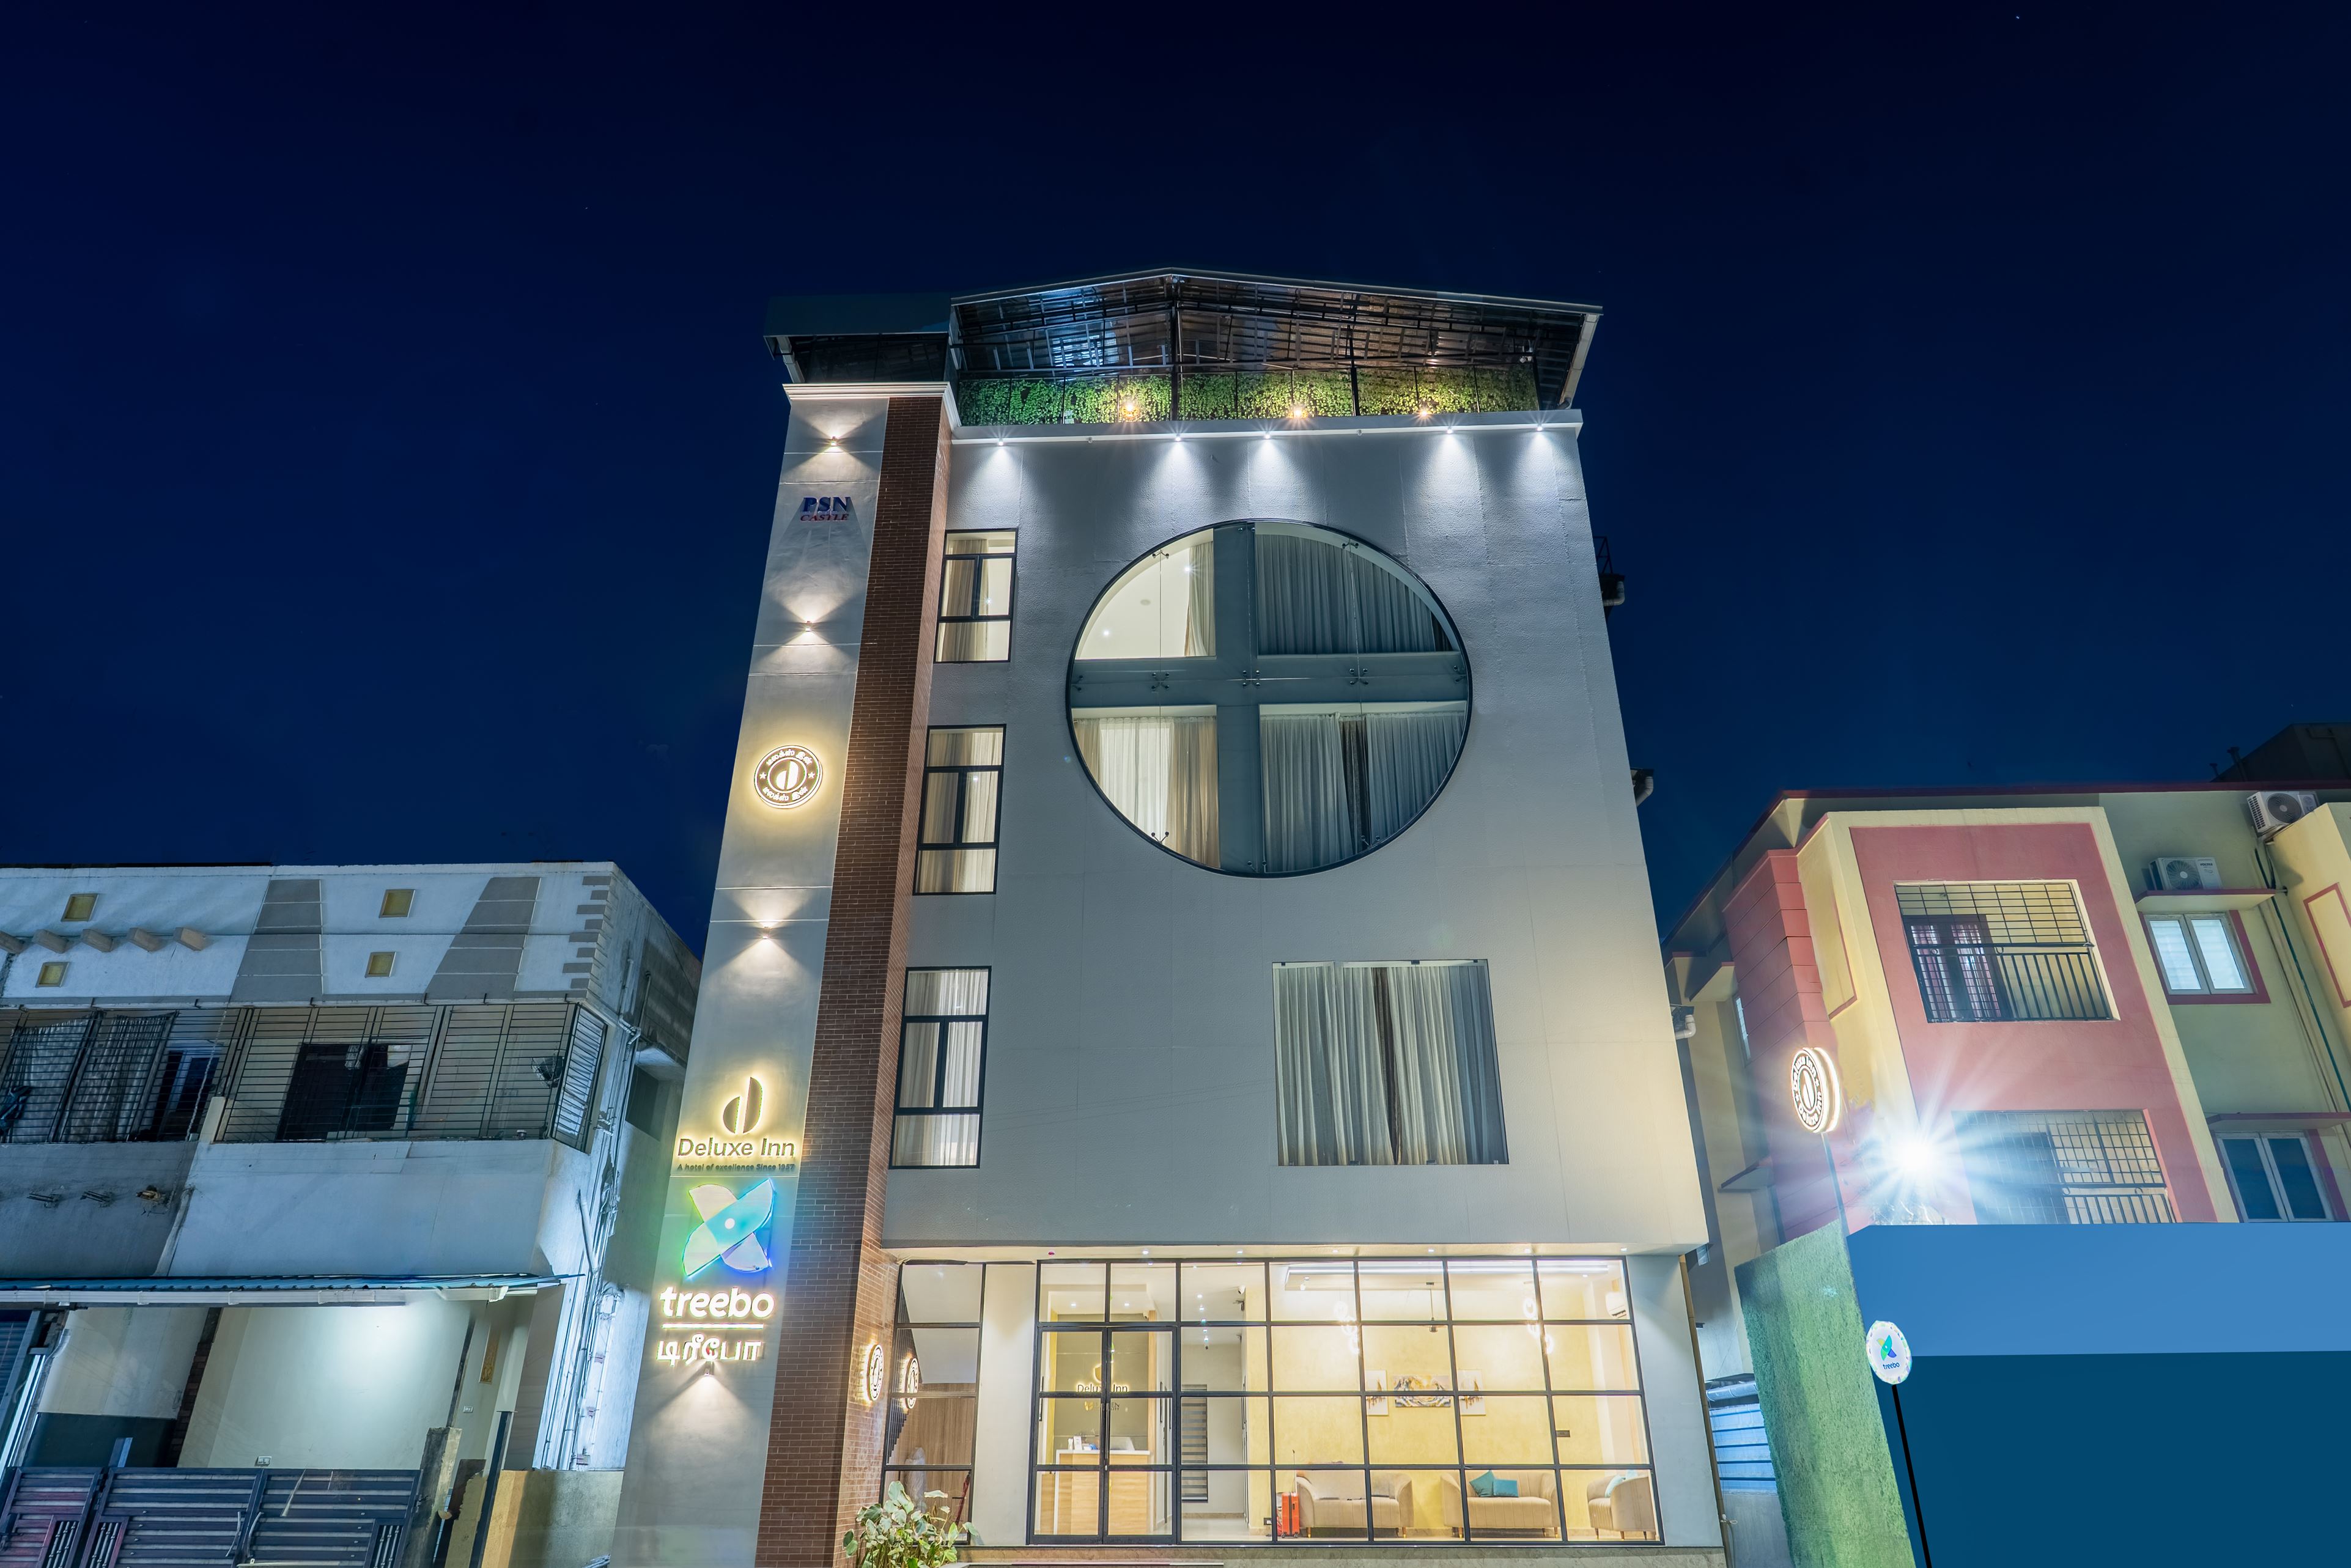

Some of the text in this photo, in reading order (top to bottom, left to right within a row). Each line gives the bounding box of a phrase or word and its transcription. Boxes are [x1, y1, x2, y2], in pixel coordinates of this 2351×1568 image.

[802, 496, 852, 512] PSN
[677, 1137, 795, 1157] Deluxe Inn
[660, 1286, 775, 1318] treebo
[1883, 1361, 1900, 1370] treebo
[1077, 1383, 1128, 1392] Delu Inn
